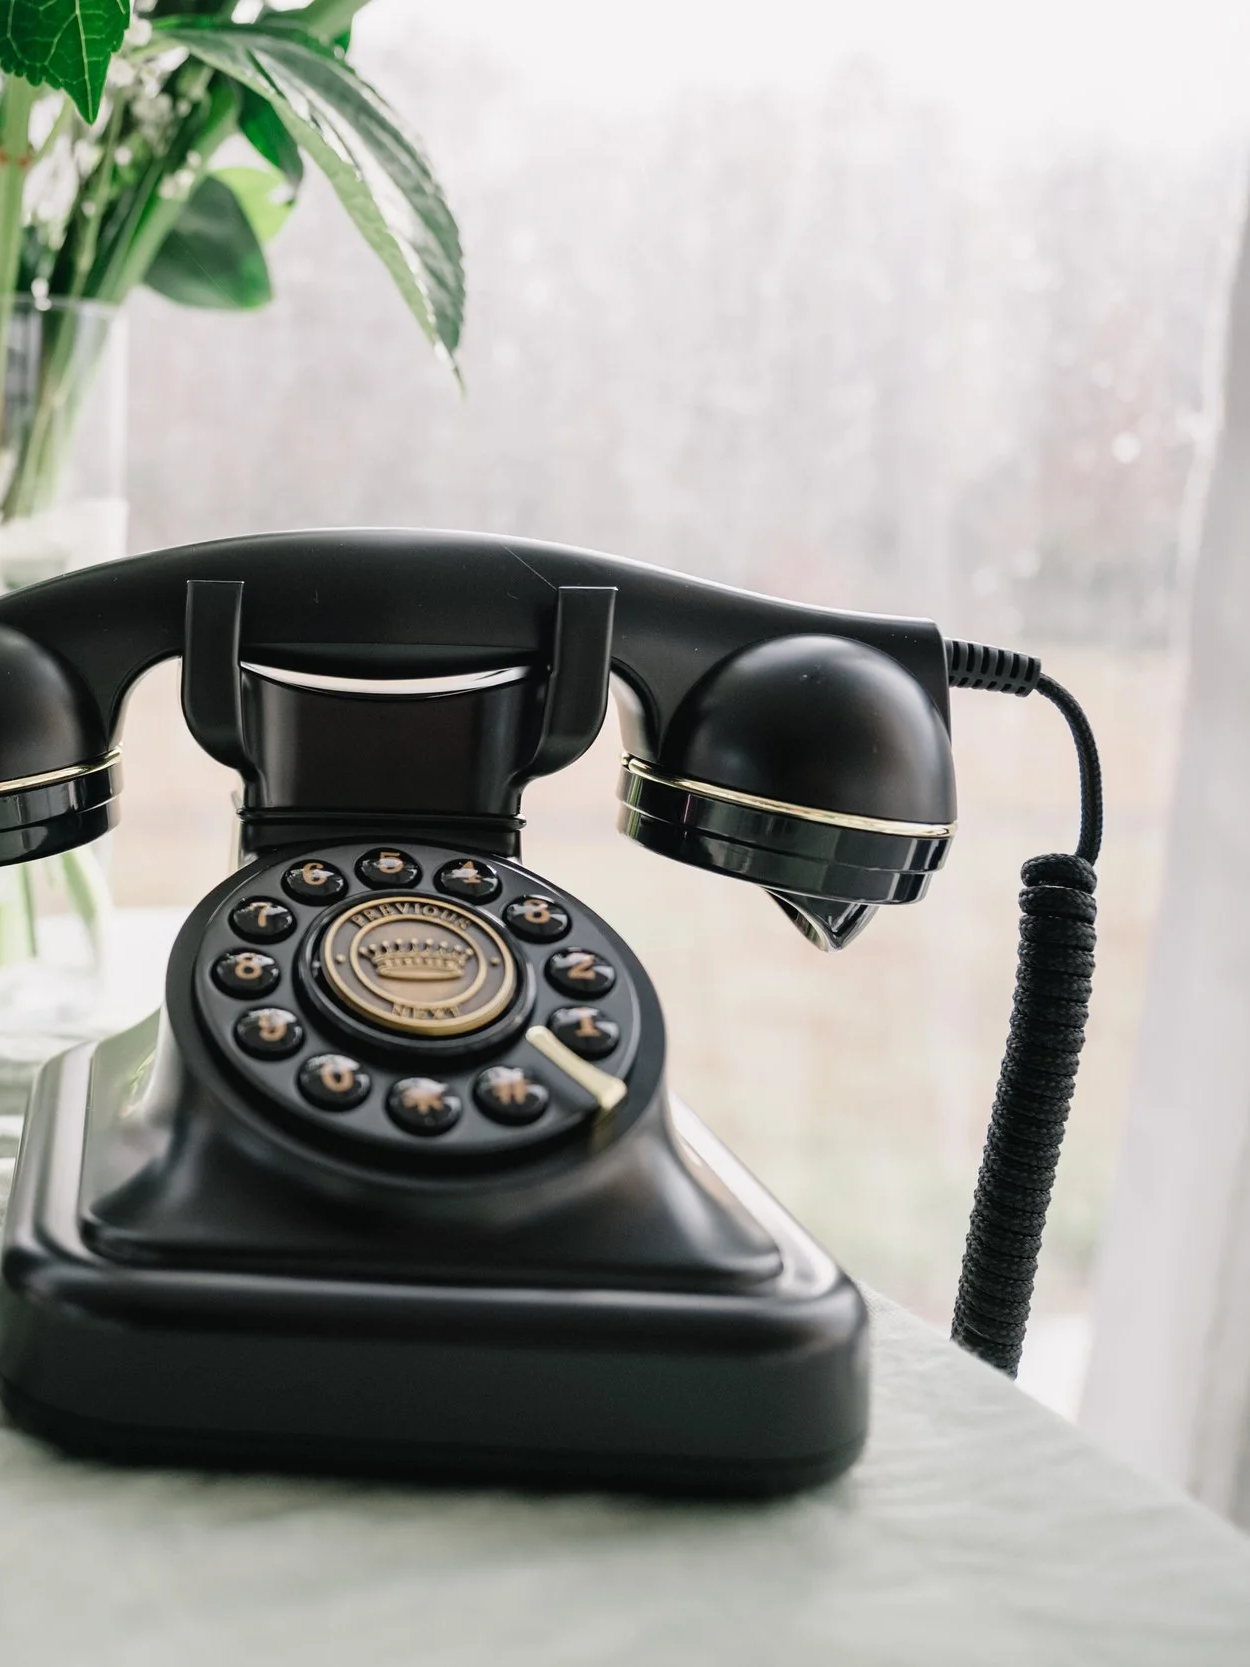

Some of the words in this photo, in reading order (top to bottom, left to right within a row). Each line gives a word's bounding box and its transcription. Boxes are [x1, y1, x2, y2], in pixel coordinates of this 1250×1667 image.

[303, 862, 327, 886] 6
[380, 852, 404, 874] 5
[250, 901, 272, 928] 7
[234, 952, 263, 980] 8
